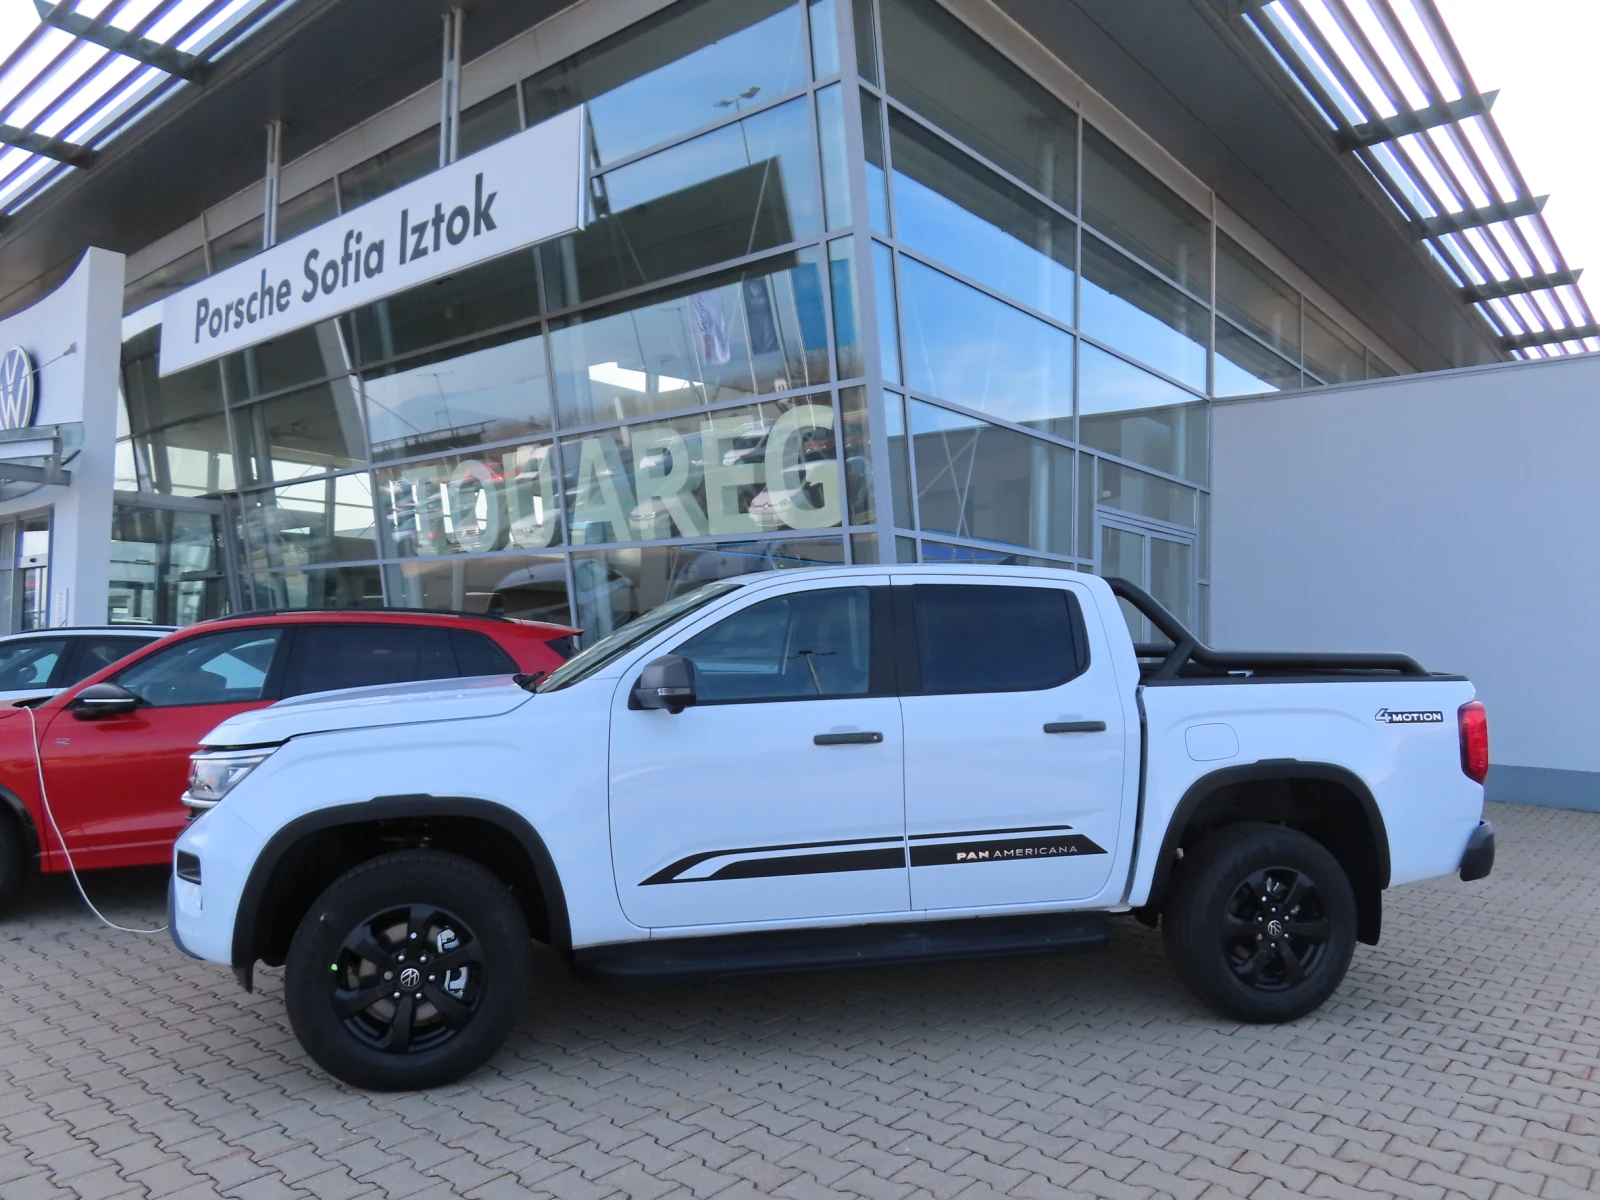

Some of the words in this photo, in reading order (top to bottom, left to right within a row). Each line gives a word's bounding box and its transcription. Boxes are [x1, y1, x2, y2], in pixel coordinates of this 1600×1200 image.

[194, 268, 292, 344] Porsche
[301, 228, 385, 303] Sofia
[399, 172, 498, 266] Iztok
[401, 404, 845, 557] TOUAREG
[1374, 708, 1444, 723] 4MOTION
[956, 850, 989, 861] PAN
[993, 845, 1078, 858] AMERICANA
